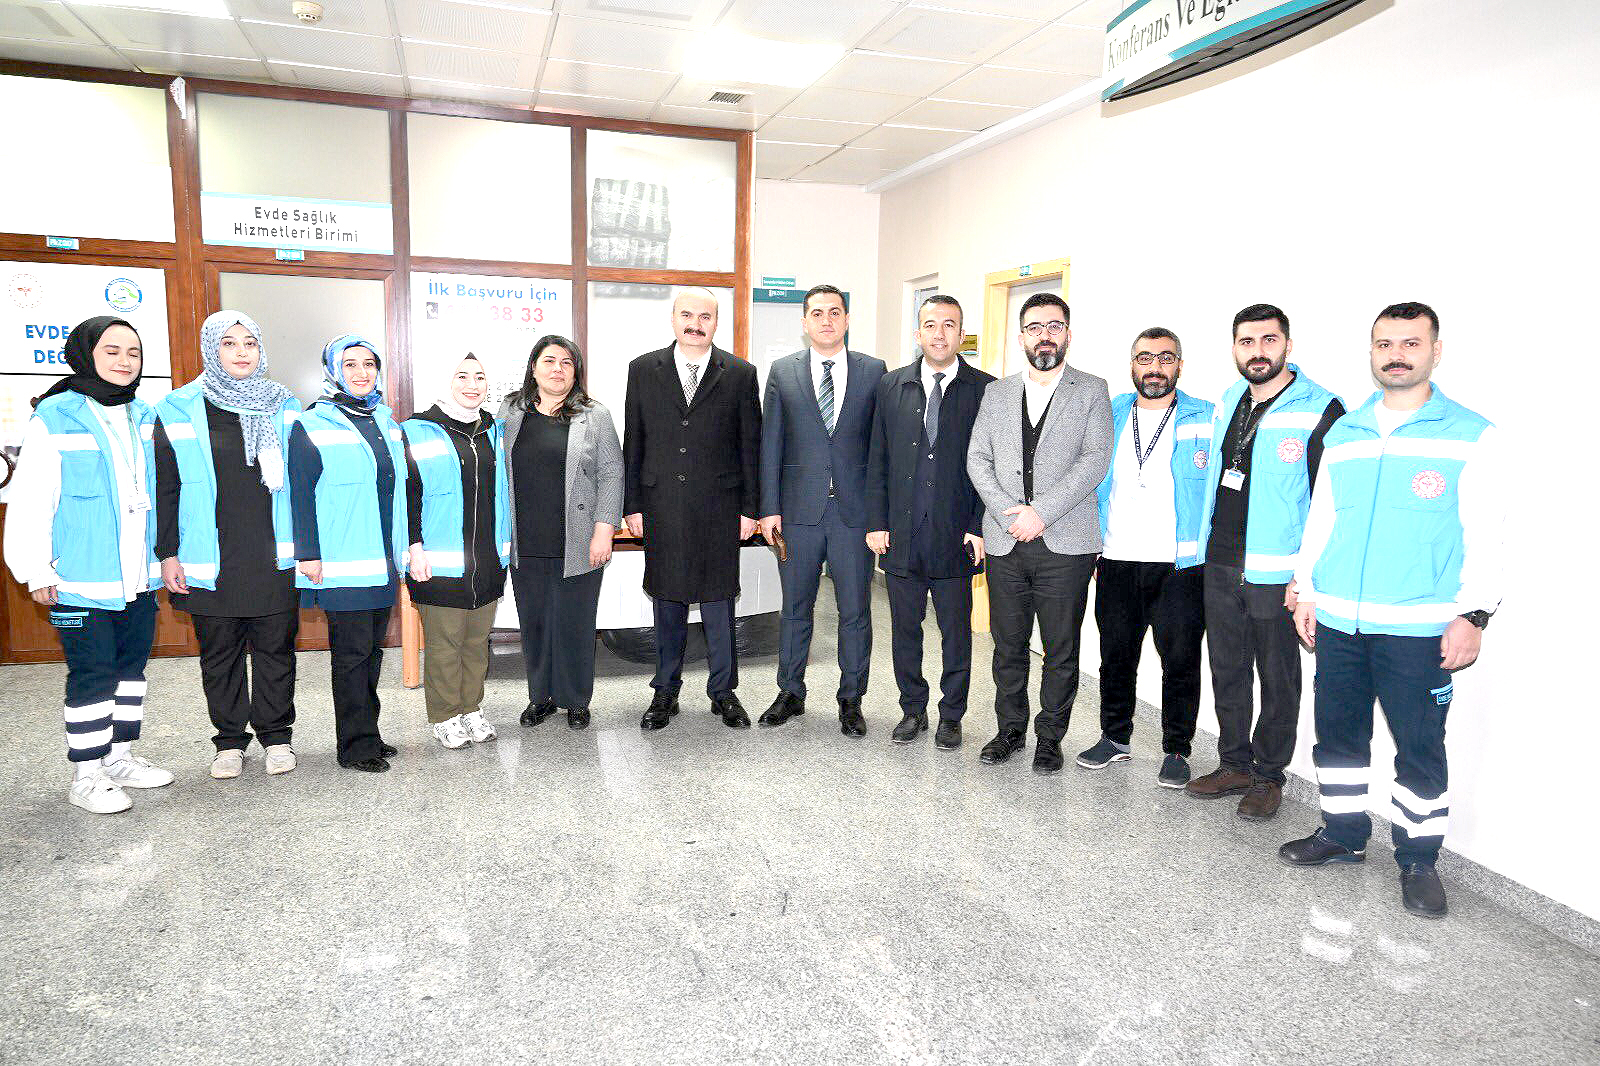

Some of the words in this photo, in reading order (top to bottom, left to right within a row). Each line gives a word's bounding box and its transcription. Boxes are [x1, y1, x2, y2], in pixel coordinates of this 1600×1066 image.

[1108, 12, 1170, 73] Konferans
[1176, 0, 1196, 29] Ve
[254, 206, 289, 221] Evde
[293, 209, 337, 226] Sağlık
[234, 222, 311, 239] Hizmetleri
[315, 227, 358, 243] Birimi
[428, 278, 450, 296] İlk
[456, 283, 523, 302] Başvuru
[530, 283, 557, 304] İçin
[489, 305, 513, 321] 38
[521, 307, 544, 323] 33
[25, 324, 70, 340] EVDE
